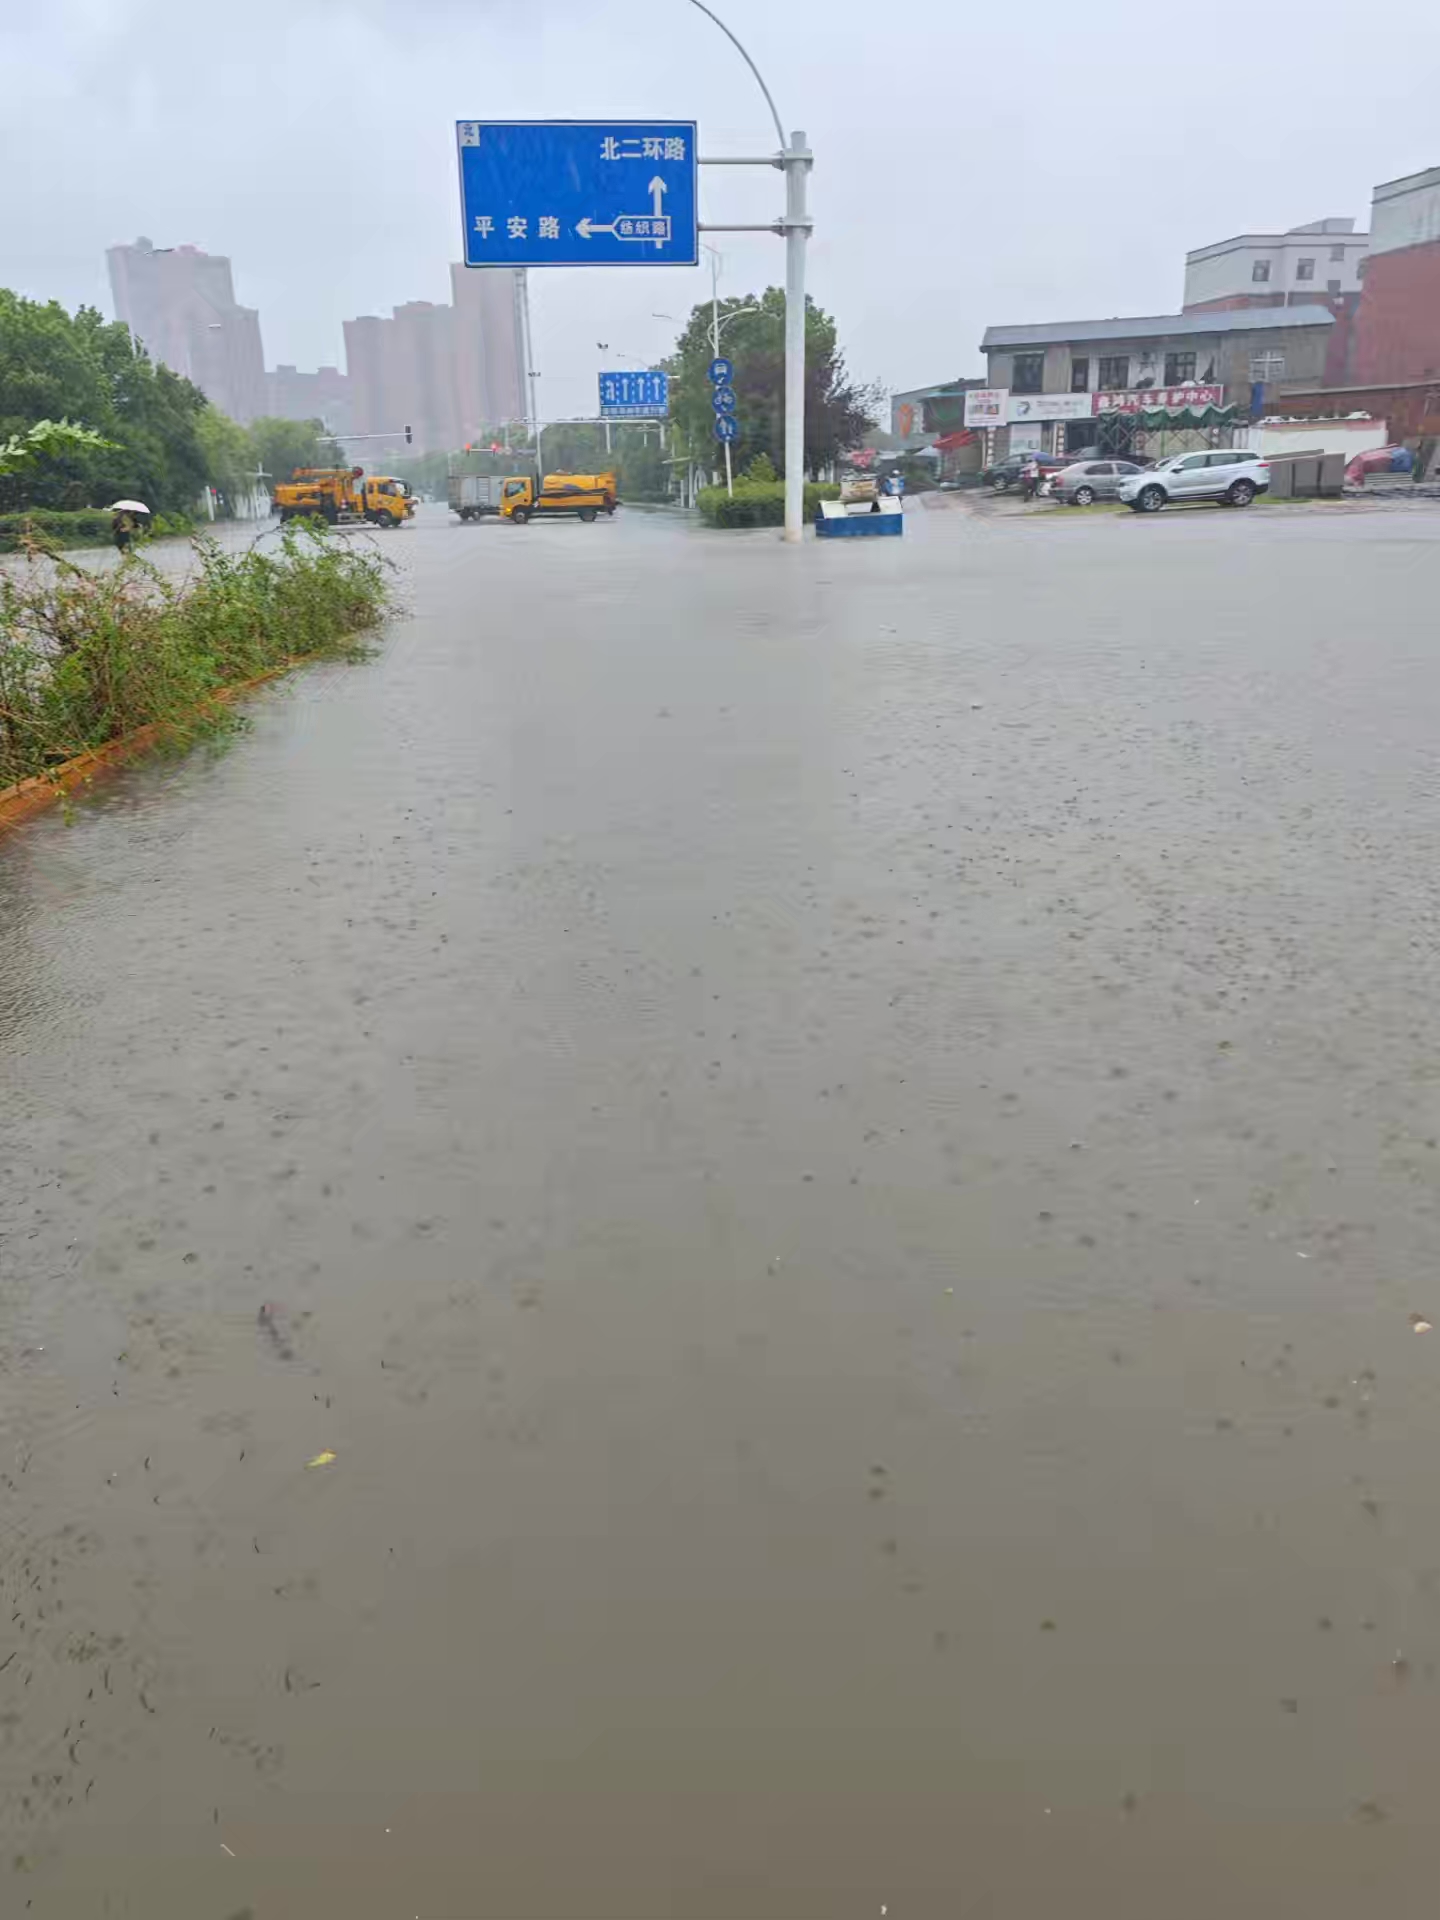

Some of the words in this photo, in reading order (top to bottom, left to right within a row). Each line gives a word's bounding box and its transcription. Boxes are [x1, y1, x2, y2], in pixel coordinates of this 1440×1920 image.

[600, 137, 686, 161] 北二环路
[473, 215, 561, 239] 平安路
[620, 220, 666, 236] 纺织路
